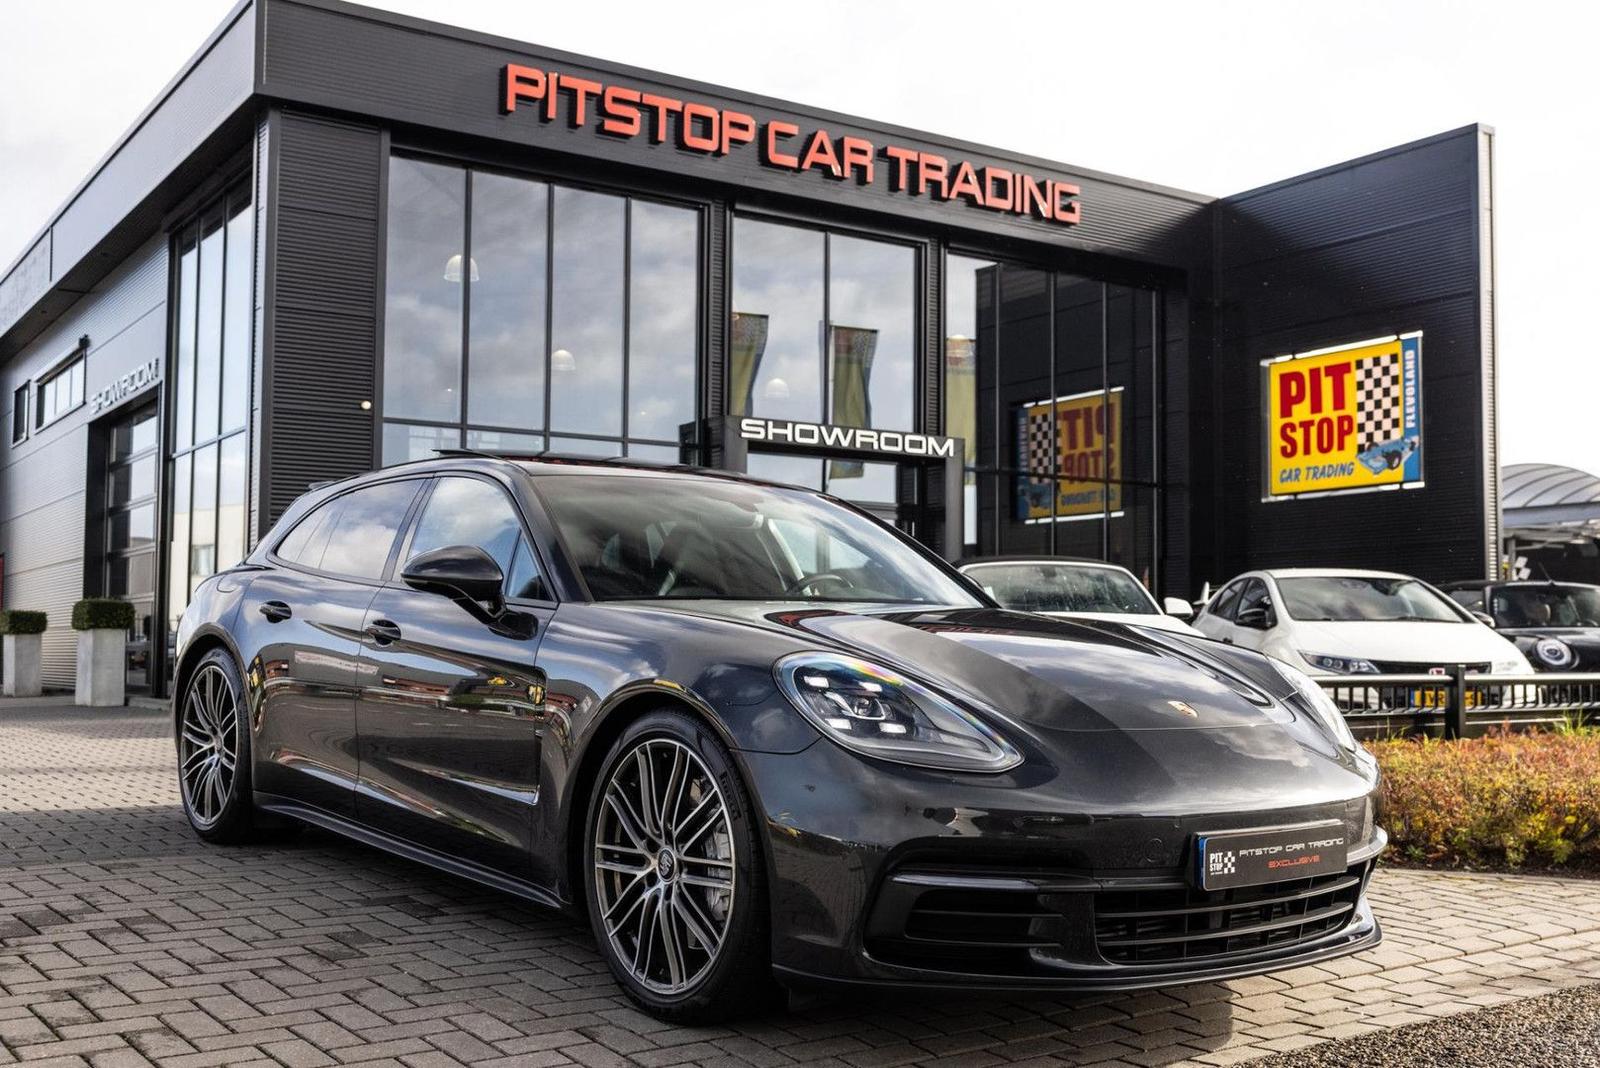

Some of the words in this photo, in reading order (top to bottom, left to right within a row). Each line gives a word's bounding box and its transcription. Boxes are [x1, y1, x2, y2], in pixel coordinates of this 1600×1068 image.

[505, 63, 756, 156] PITSTOP
[767, 121, 874, 185] CAR
[886, 146, 1081, 225] TRADING
[1279, 362, 1352, 418] PIT
[1405, 349, 1416, 428] FLEVOLAND
[740, 418, 955, 457] SHOWROOM
[1280, 415, 1354, 459] STOP
[1280, 468, 1302, 484] CAR
[1306, 462, 1355, 481] TRADING
[1210, 852, 1224, 863] PIT
[1239, 846, 1283, 857] PITSTOP
[1285, 842, 1305, 853] CAR
[1308, 838, 1344, 848] TRADING
[1268, 855, 1320, 868] EXCLUSIVE
[1210, 862, 1224, 872] STOP
